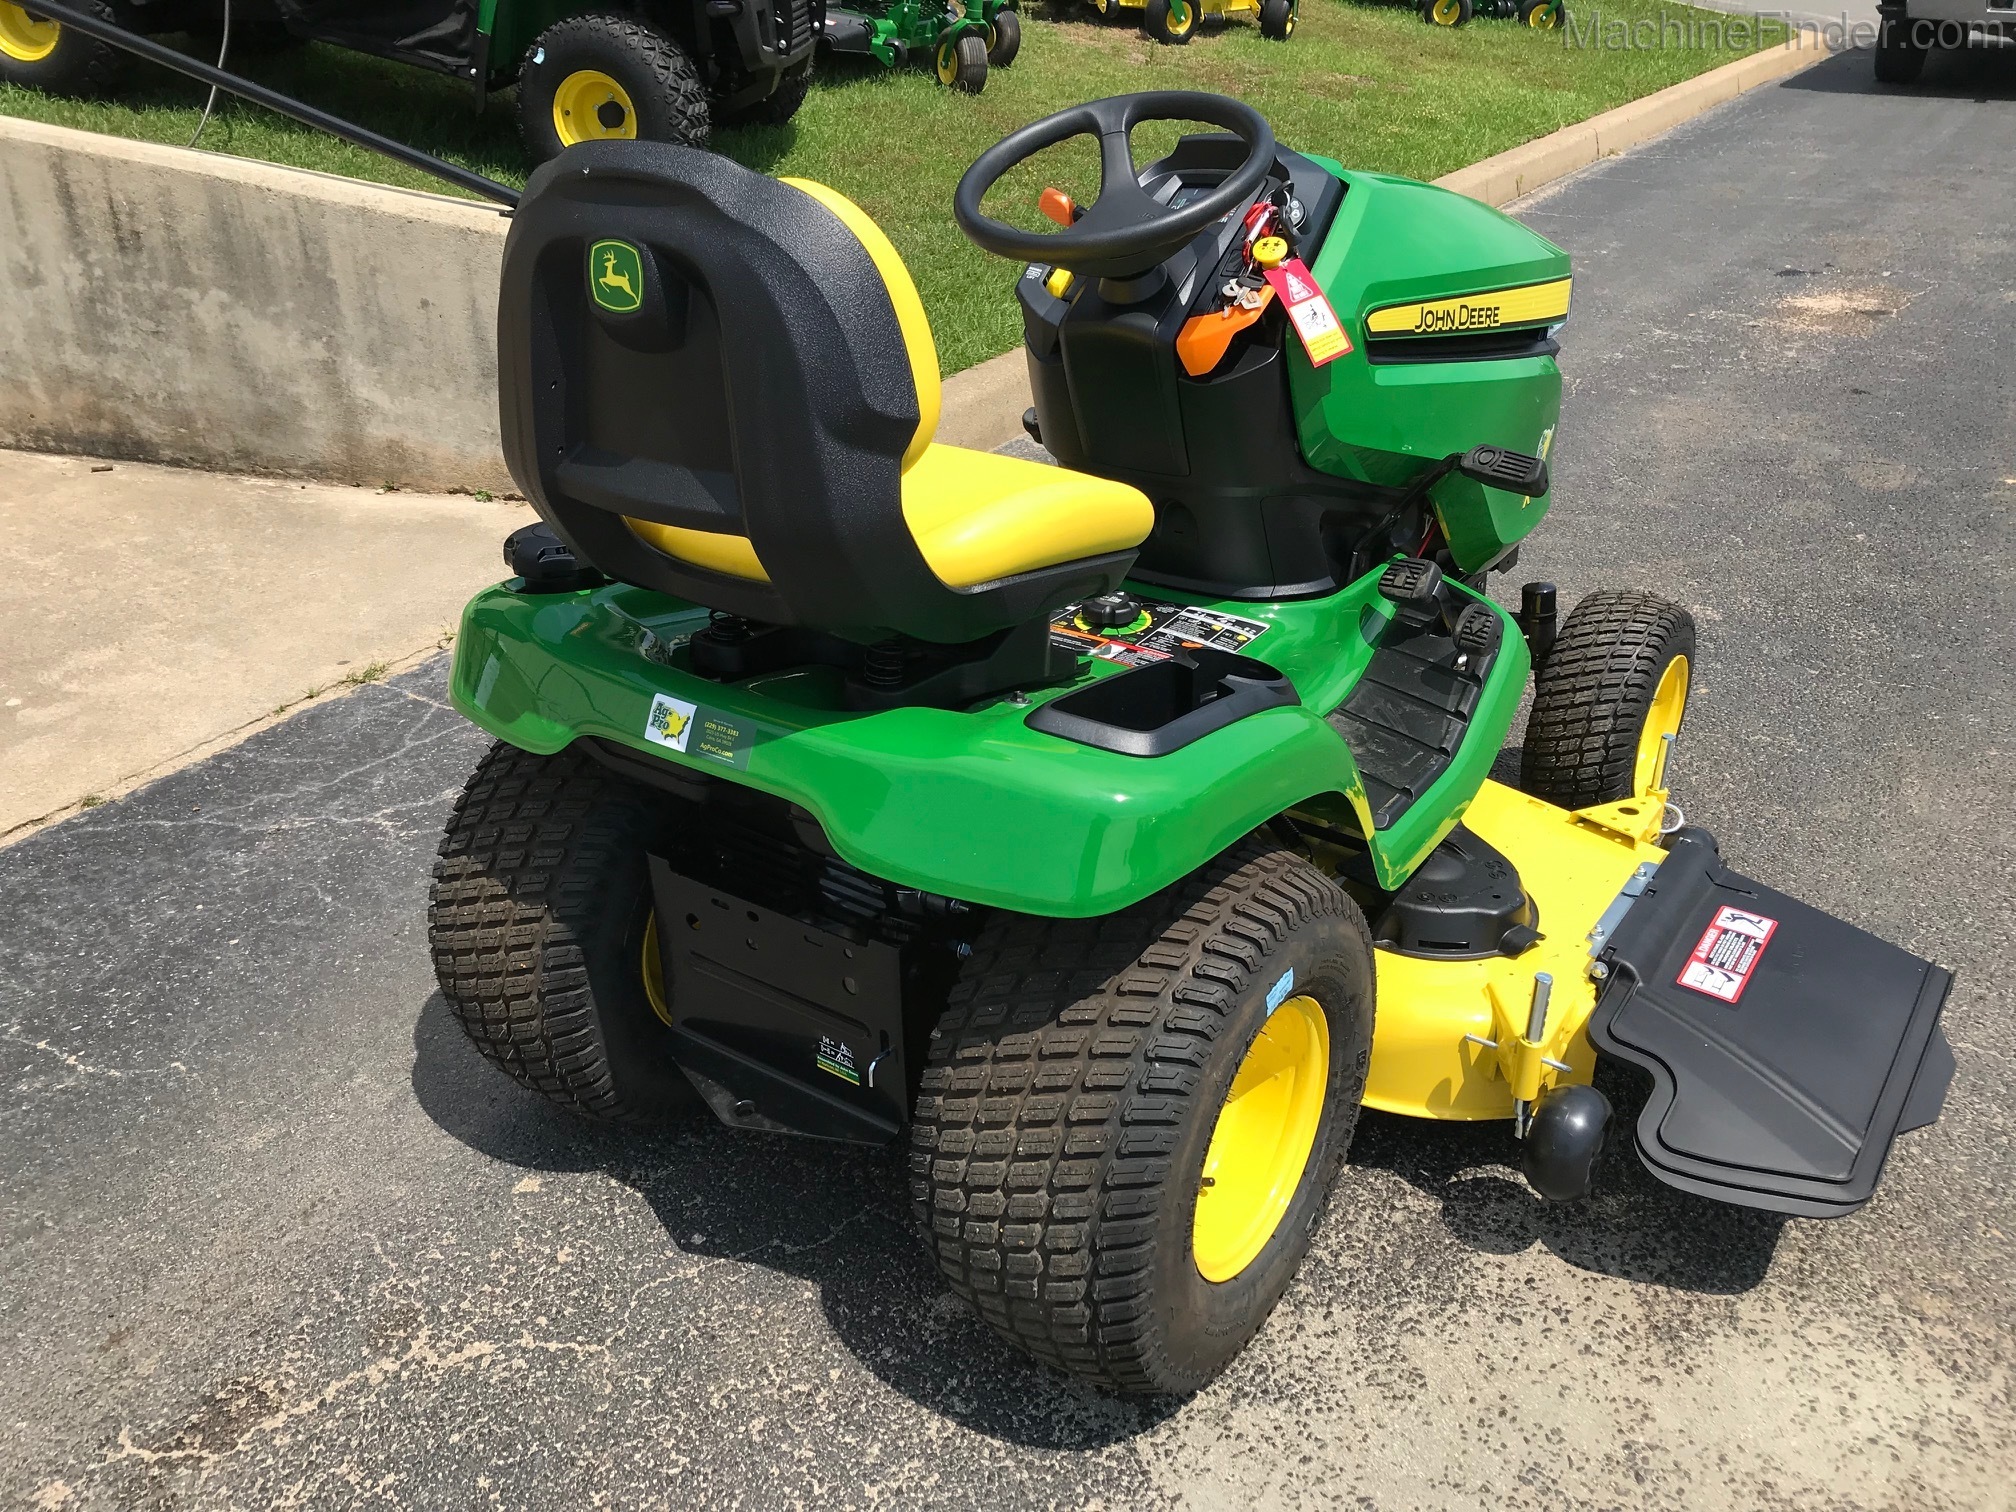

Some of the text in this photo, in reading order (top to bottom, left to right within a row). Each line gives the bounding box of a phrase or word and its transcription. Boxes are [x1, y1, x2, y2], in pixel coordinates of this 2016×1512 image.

[1414, 304, 1500, 333] JOHN DEERE
[650, 714, 670, 731] Pro
[700, 742, 734, 758] AgProCo.com
[1698, 928, 1720, 953] DANGER
